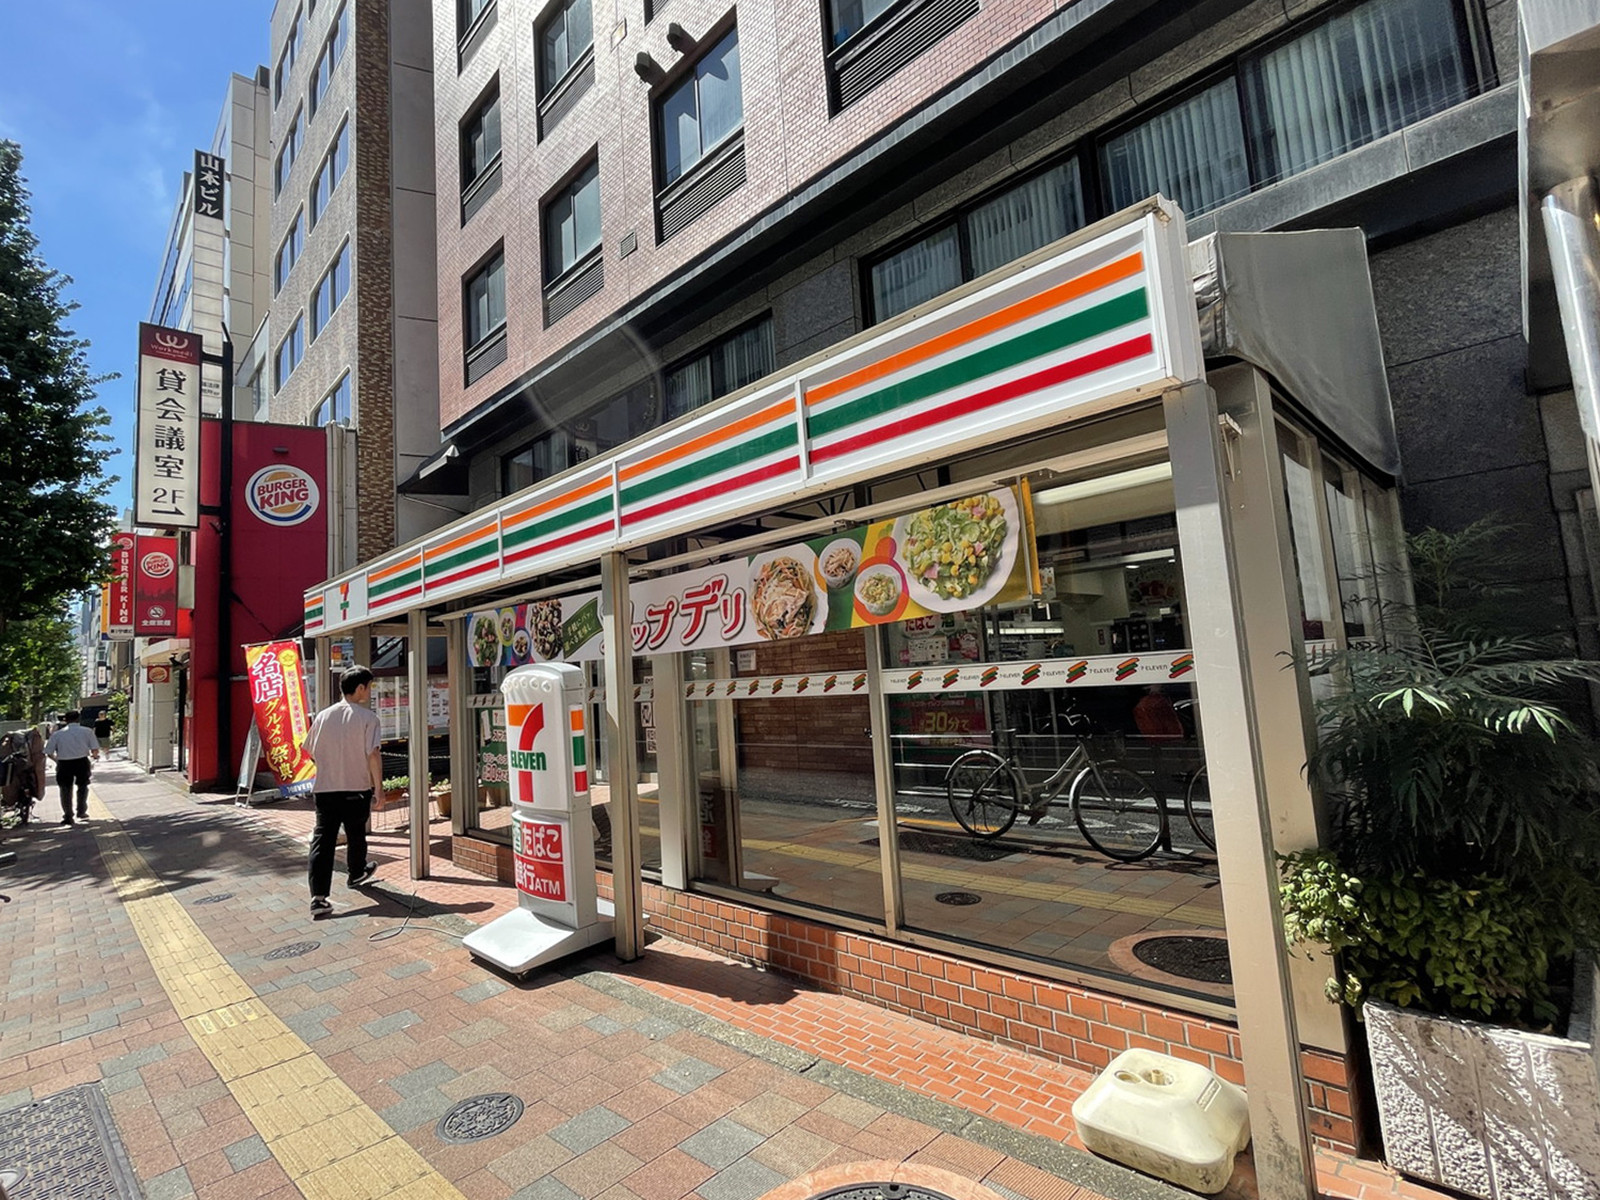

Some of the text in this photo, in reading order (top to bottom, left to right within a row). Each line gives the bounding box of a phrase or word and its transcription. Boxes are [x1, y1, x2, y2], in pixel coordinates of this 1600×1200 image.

[198, 154, 220, 216] 山本ビル
[154, 367, 187, 480] 貸会議室
[152, 487, 185, 504] 2F
[257, 478, 307, 496] BURGER
[259, 488, 309, 509] KING
[119, 595, 128, 623] KING
[602, 577, 743, 650] ップデリ
[523, 826, 561, 859] たばこ
